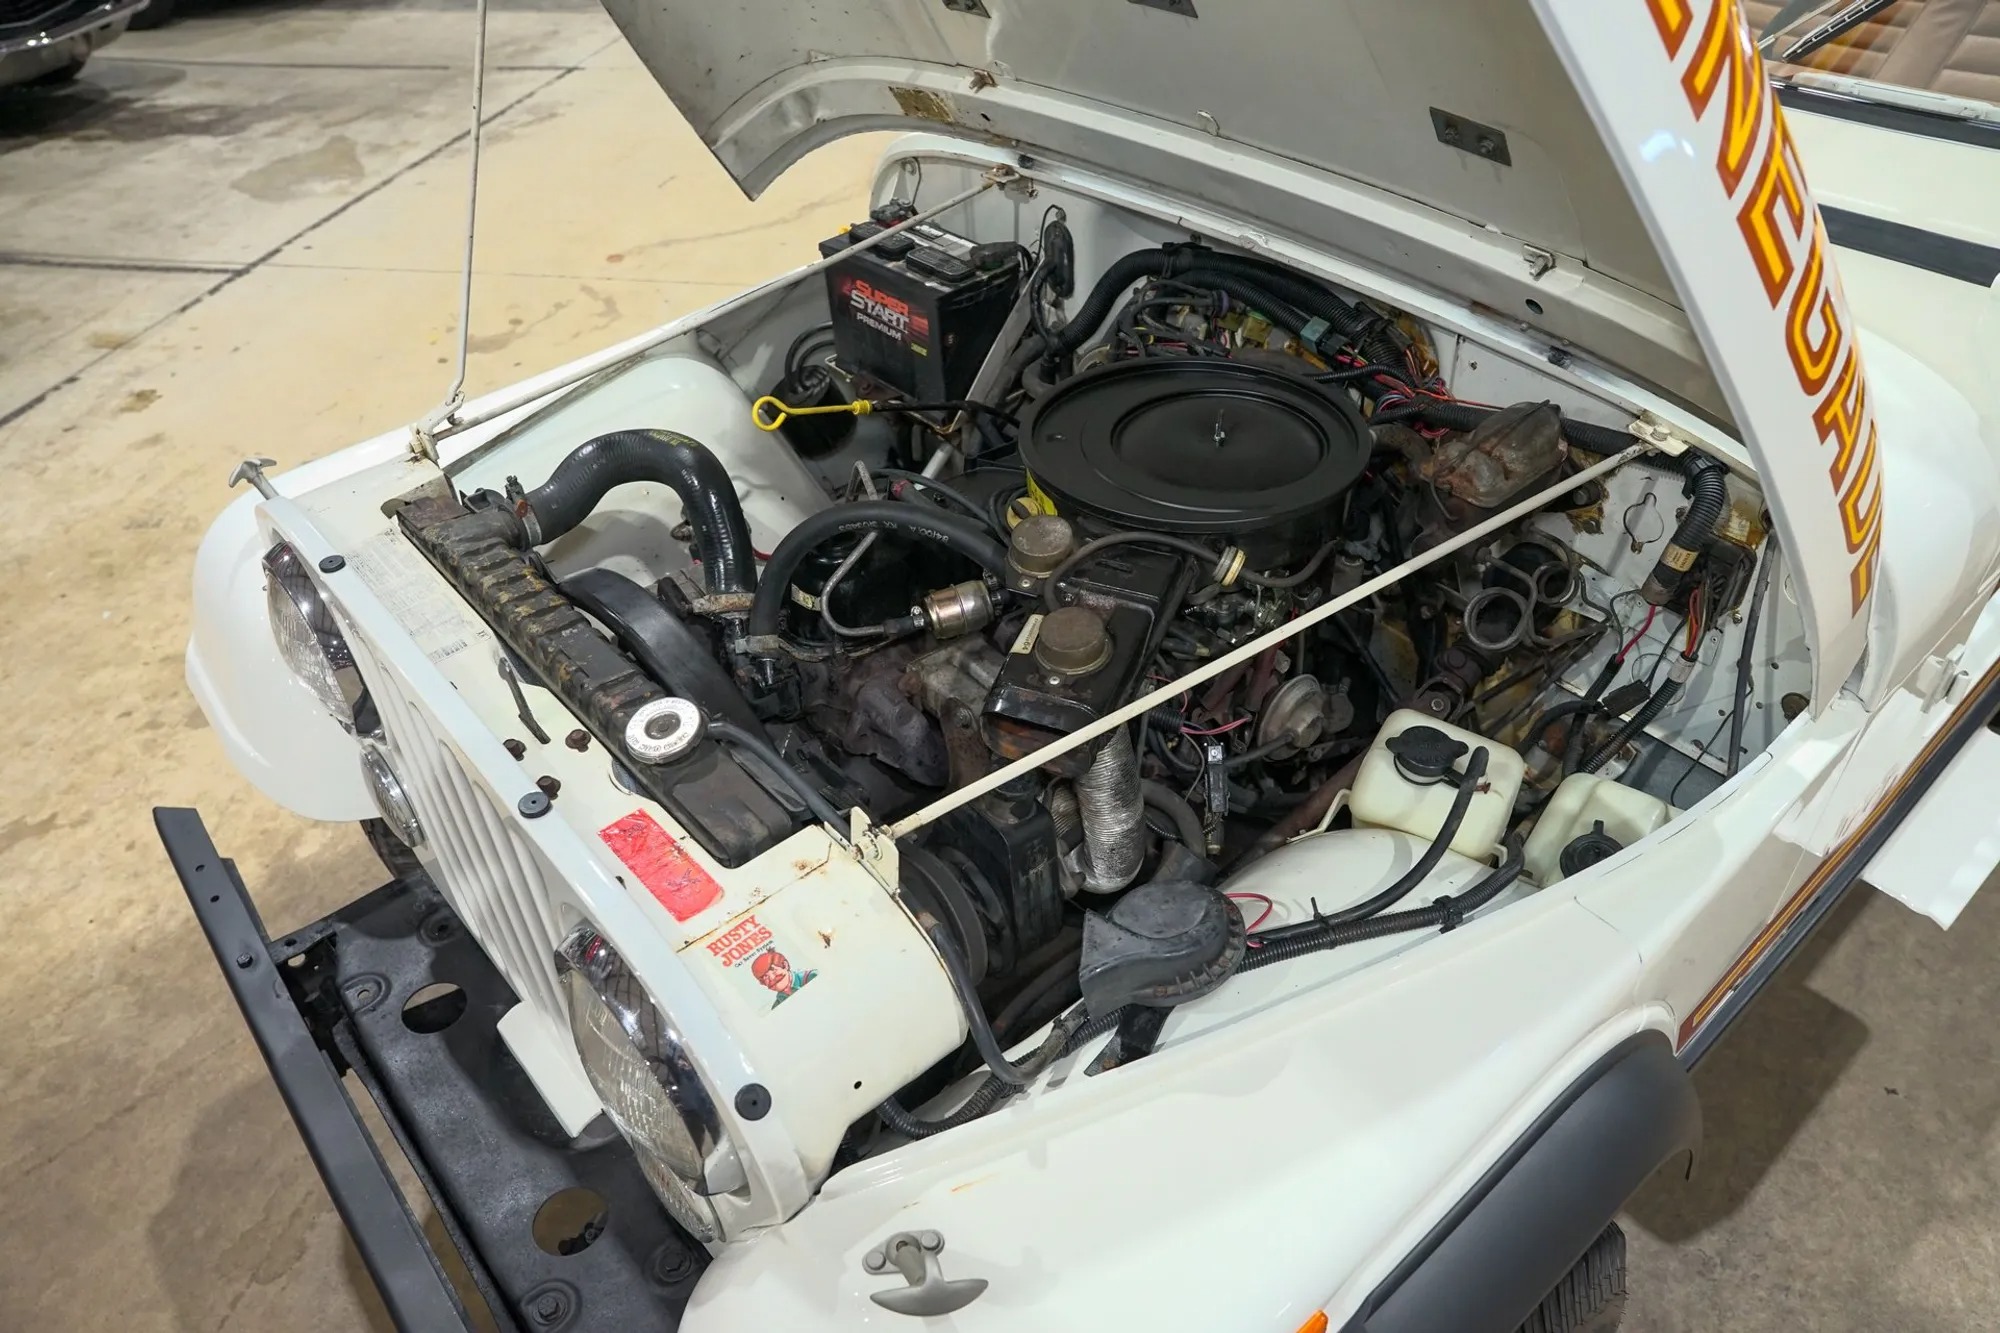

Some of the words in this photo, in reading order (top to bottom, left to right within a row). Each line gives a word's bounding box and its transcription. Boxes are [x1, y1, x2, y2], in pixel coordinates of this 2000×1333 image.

[850, 289, 910, 329] START
[855, 279, 909, 317] SUPER
[856, 312, 902, 341] PREMIUM
[706, 914, 761, 957] RUSTY
[722, 927, 773, 967] JONES
